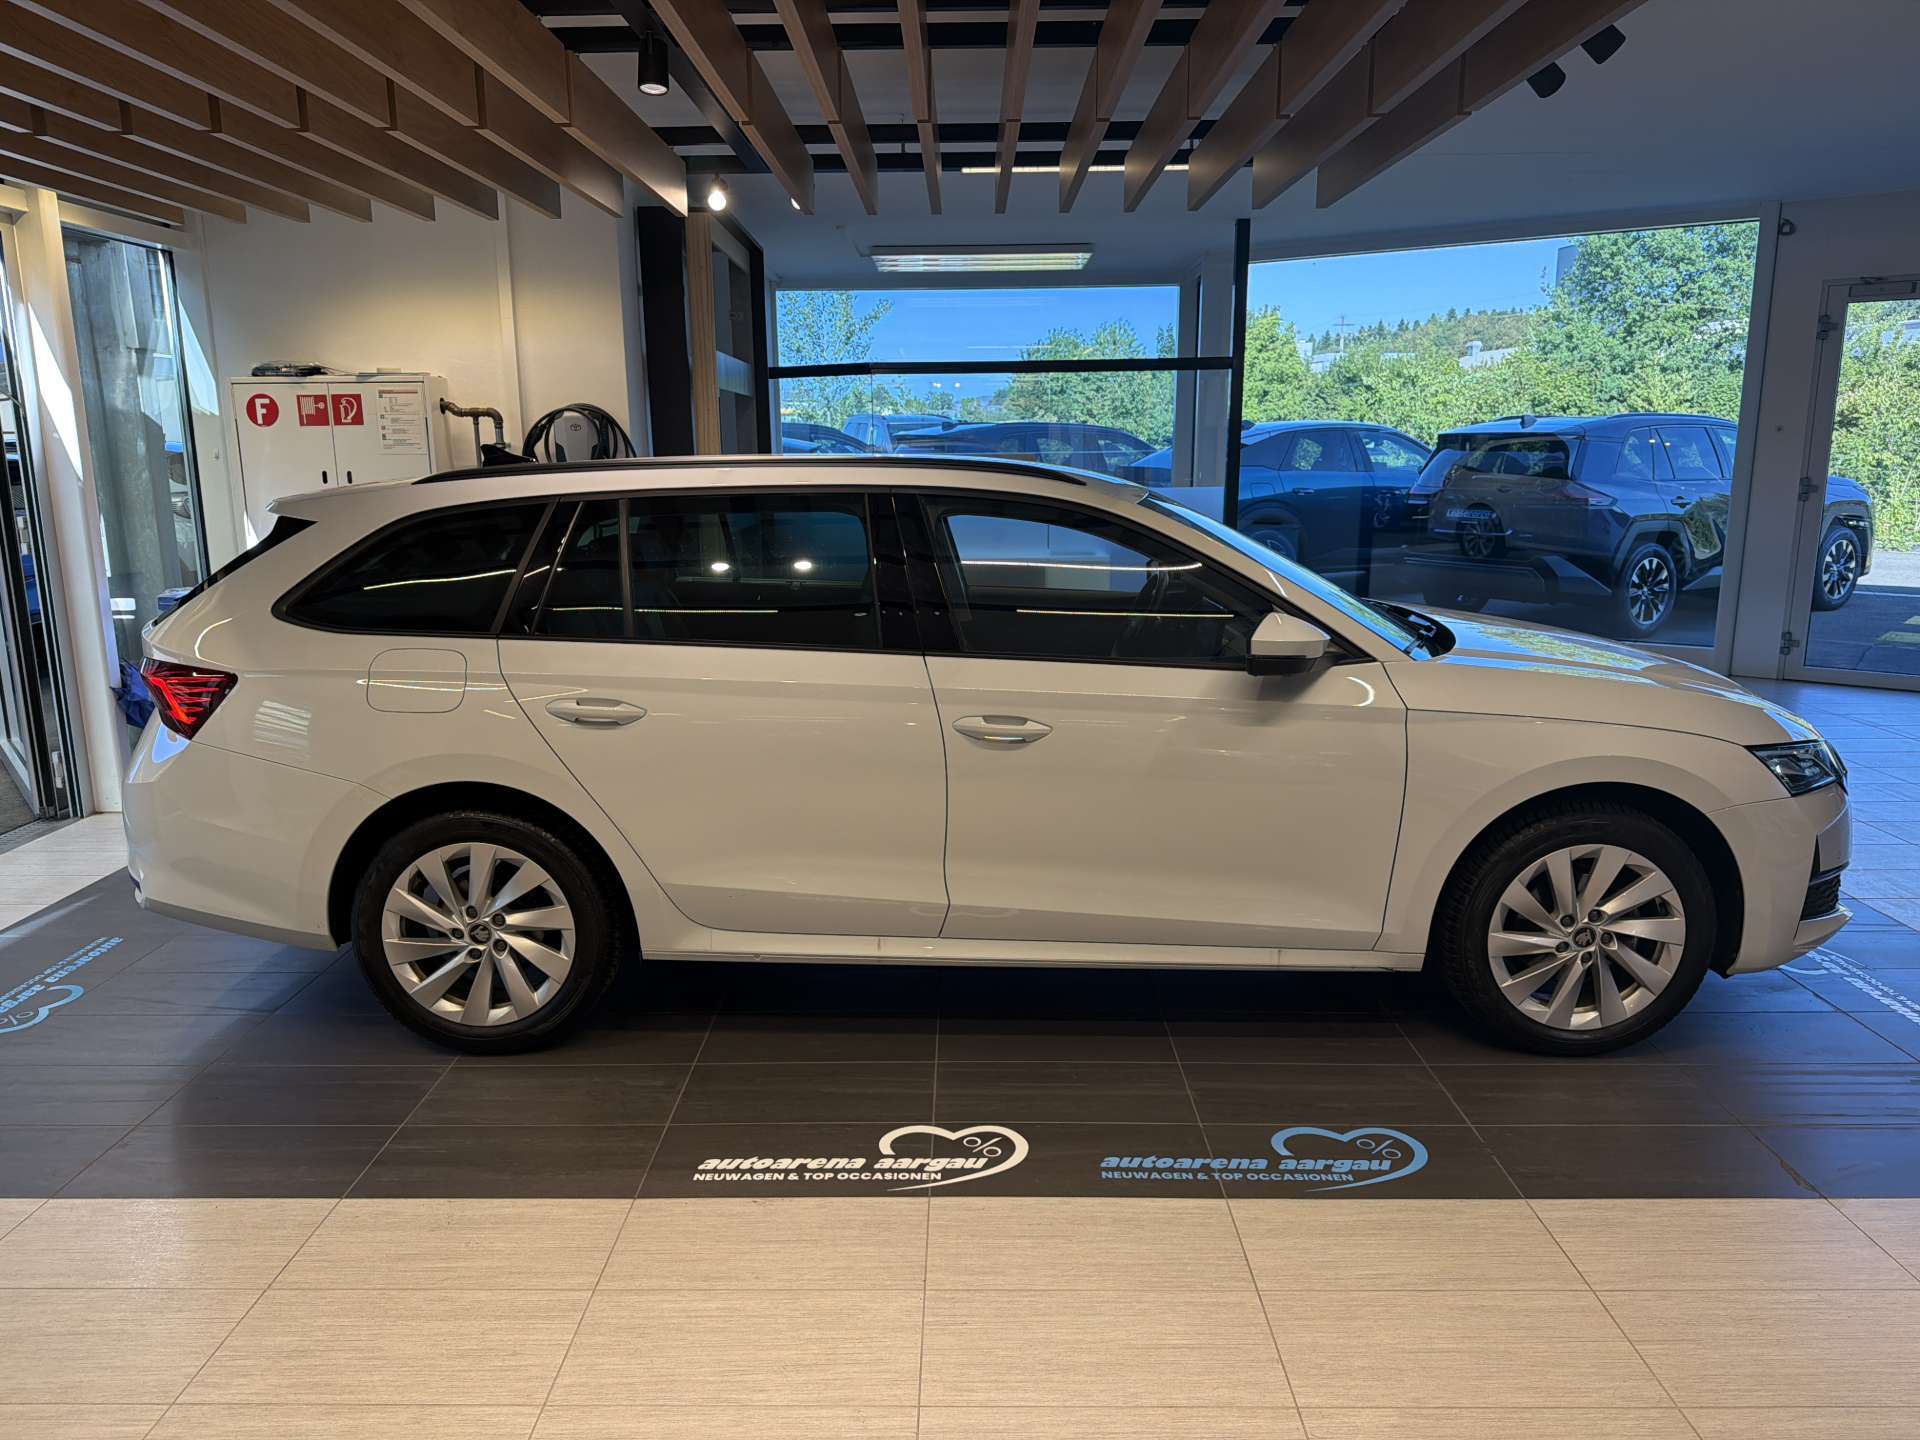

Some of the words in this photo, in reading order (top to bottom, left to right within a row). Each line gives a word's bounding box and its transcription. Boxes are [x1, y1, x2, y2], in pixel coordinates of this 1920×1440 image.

[255, 398, 270, 425] F
[698, 1156, 867, 1170] autoarena
[873, 1157, 989, 1172] aargau
[1100, 1155, 1268, 1169] autoarena
[1278, 1159, 1391, 1173] aargau
[693, 1172, 785, 1181] NEUWAGEN
[787, 1172, 800, 1180] &
[803, 1172, 835, 1181] TOP
[837, 1172, 942, 1181] OCCASIONEN
[1101, 1171, 1194, 1180] NEUWAGEN
[1197, 1171, 1209, 1180] &
[1212, 1172, 1243, 1181] TOP
[1246, 1172, 1355, 1182] OCCASIONEN
